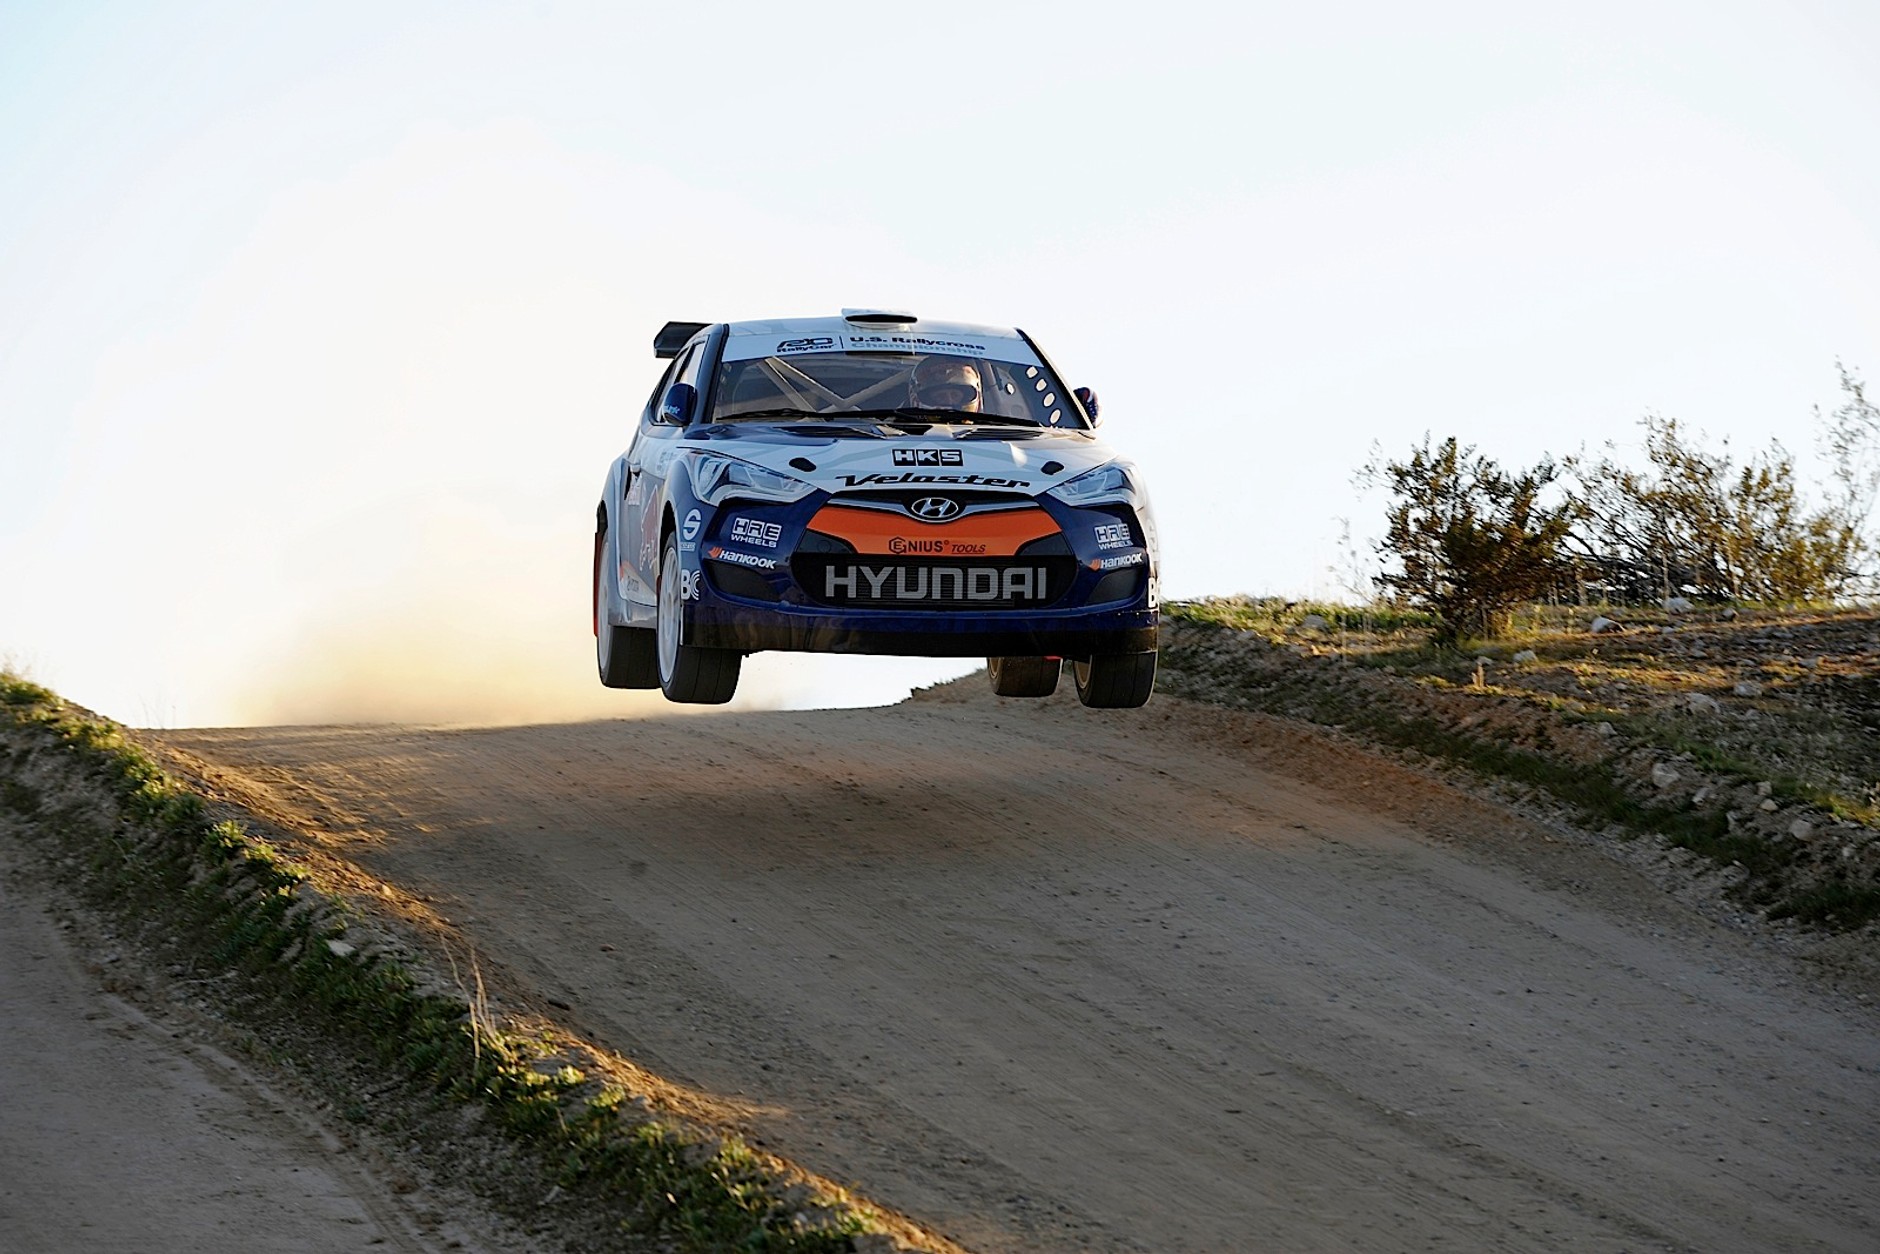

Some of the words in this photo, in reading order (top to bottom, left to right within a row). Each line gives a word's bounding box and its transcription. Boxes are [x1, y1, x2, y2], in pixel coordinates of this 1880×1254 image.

[891, 337, 986, 350] Rallycross
[893, 450, 963, 466] HKS
[835, 472, 1031, 488] Veloster
[732, 517, 782, 541] HRE
[1094, 523, 1131, 543] HRE
[731, 533, 777, 548] WHEELS
[951, 544, 986, 553] TOOLS
[825, 565, 1047, 600] HYUNDAI
